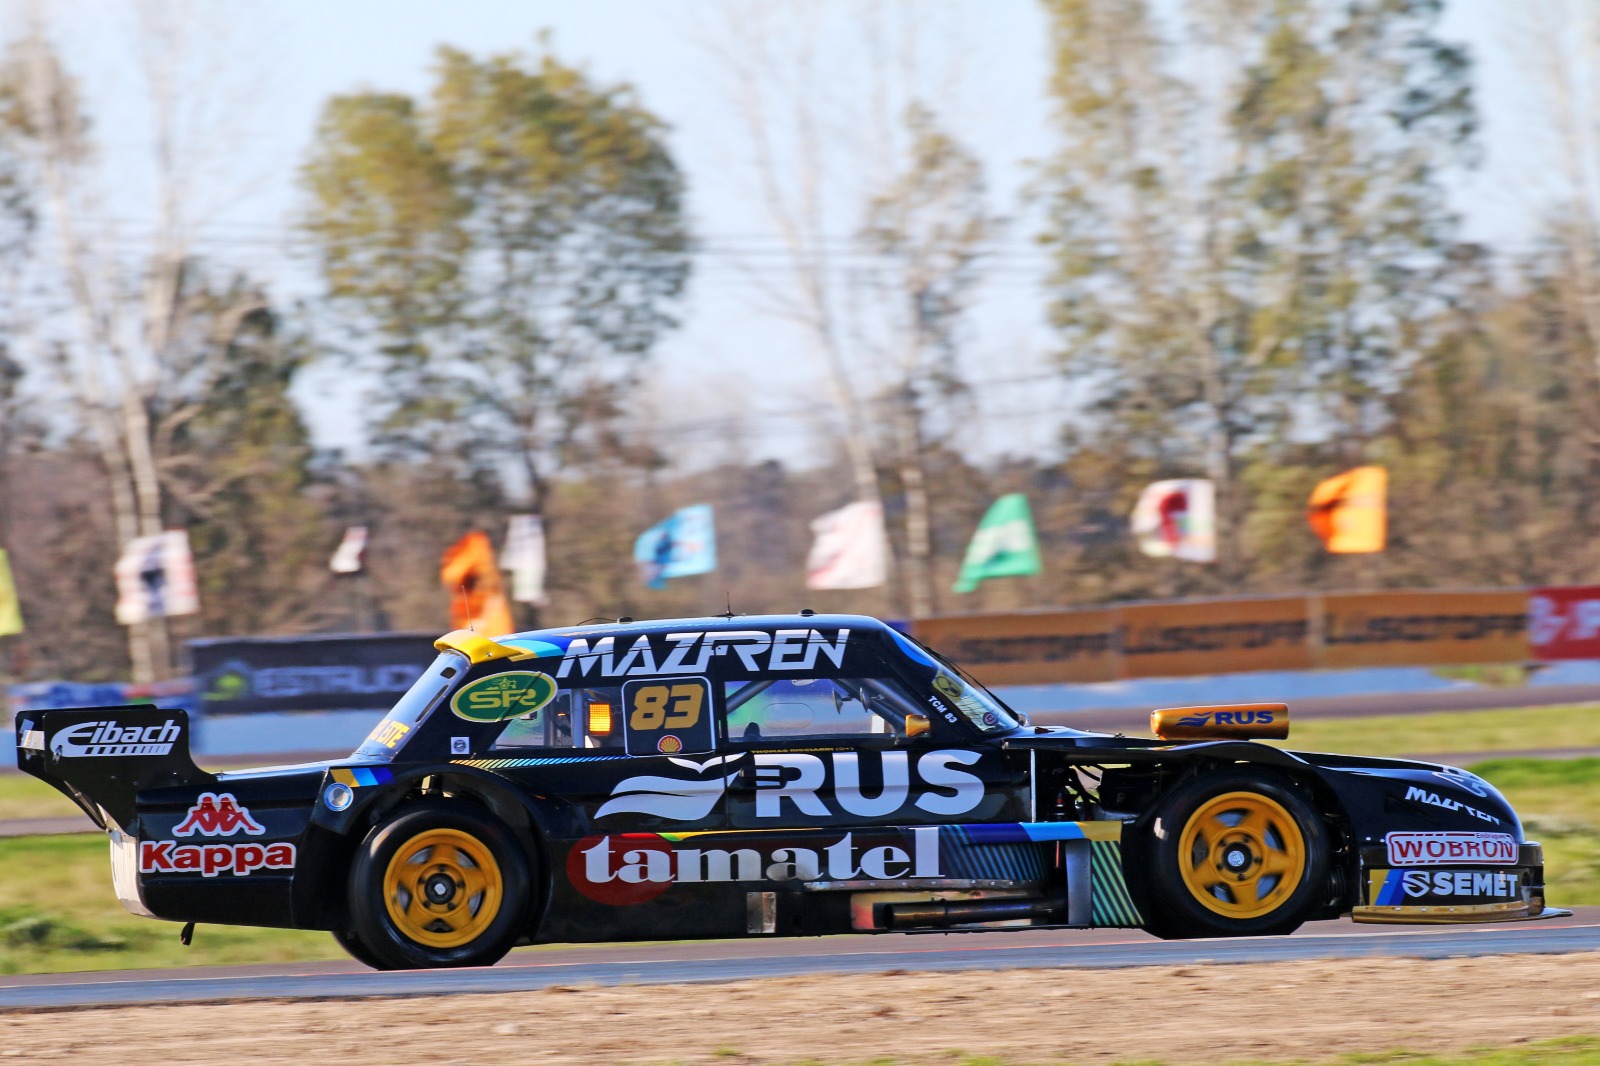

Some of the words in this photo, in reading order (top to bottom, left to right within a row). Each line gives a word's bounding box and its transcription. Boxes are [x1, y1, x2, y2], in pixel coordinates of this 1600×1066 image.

[556, 628, 850, 678] MAZFREN
[630, 683, 704, 731] 83
[928, 695, 948, 713] TCM
[944, 713, 958, 724] 83
[1214, 711, 1274, 725] RUS
[50, 719, 181, 757] Eibach
[753, 749, 985, 818] RUS
[141, 841, 295, 875] Kappa
[580, 826, 947, 885] tamatel
[1394, 840, 1514, 858] WOBRON
[1432, 871, 1518, 897] SEMET
